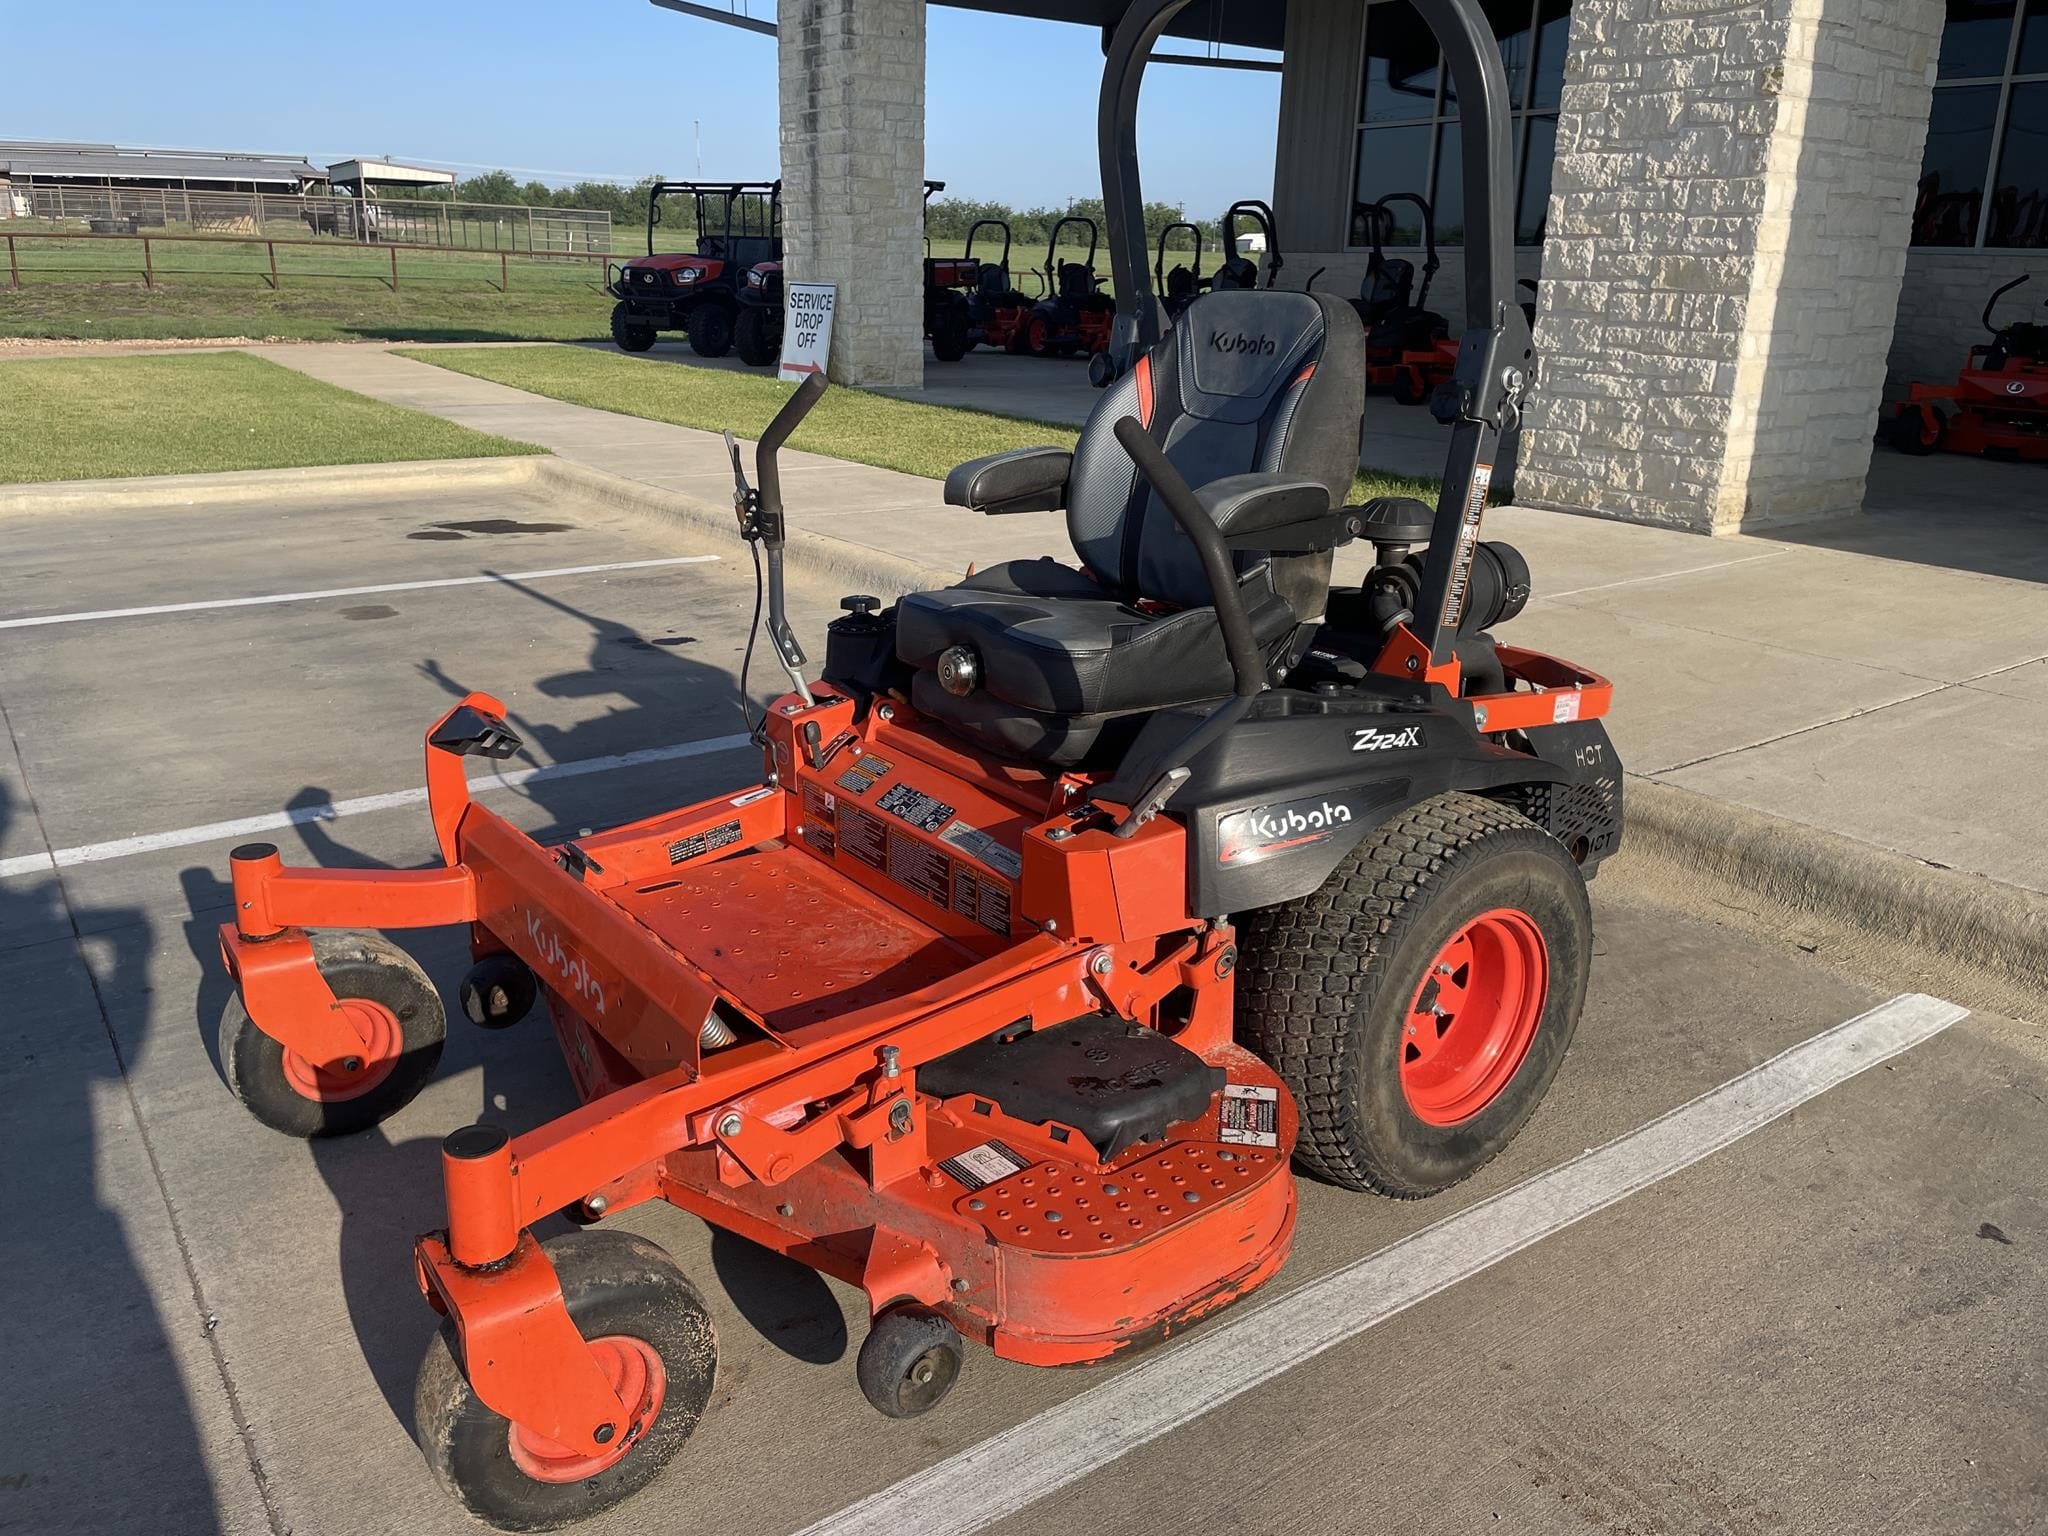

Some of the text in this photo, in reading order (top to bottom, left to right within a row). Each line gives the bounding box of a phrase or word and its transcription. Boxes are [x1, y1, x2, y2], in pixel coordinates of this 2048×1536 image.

[790, 292, 833, 311] SERVICE
[795, 312, 823, 330] DROP
[797, 332, 817, 349] OFF
[1210, 331, 1276, 357] Kubota
[1352, 726, 1420, 751] Z724X
[1575, 744, 1602, 767] HOT
[1250, 802, 1352, 839] Kubota
[526, 909, 605, 1015] Kubota
